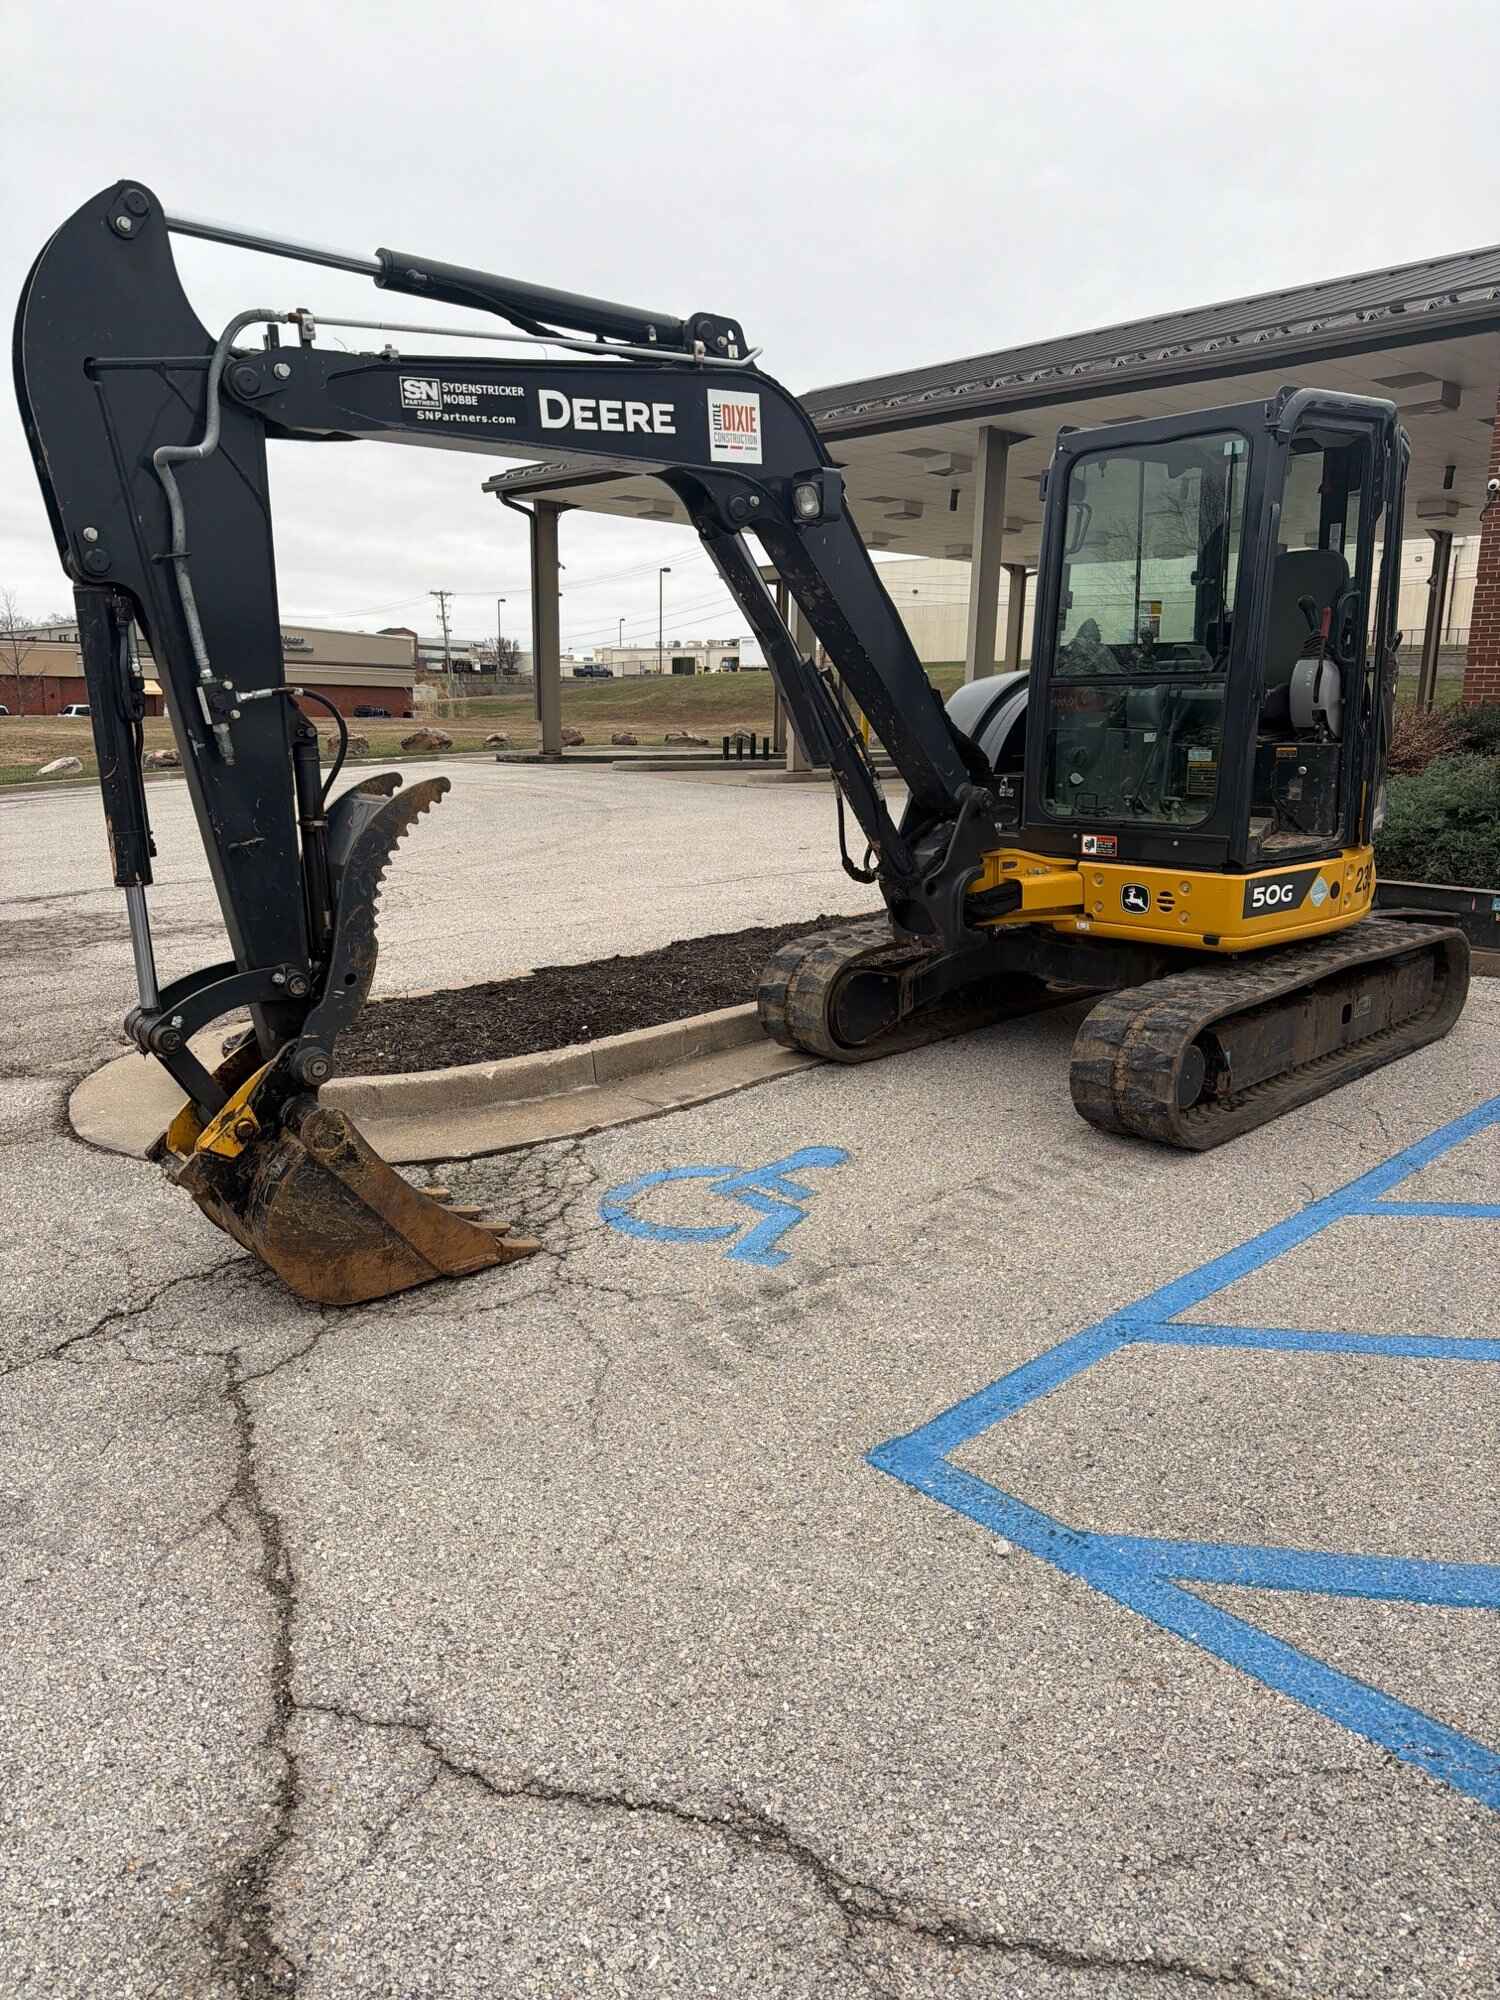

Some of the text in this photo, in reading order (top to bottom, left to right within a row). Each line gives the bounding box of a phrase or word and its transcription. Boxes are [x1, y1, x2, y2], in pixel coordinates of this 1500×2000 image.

[442, 382, 525, 397] SYDENSTRICKER
[404, 399, 440, 407] PARTNERS
[443, 394, 479, 406] NOBBE
[416, 410, 517, 425] SNPartners.com
[538, 389, 676, 434] DEERE
[712, 402, 722, 431] LITTLE
[722, 404, 757, 433] DIXIE
[713, 431, 758, 445] CONSTRUCTION
[1252, 884, 1293, 908] 50G
